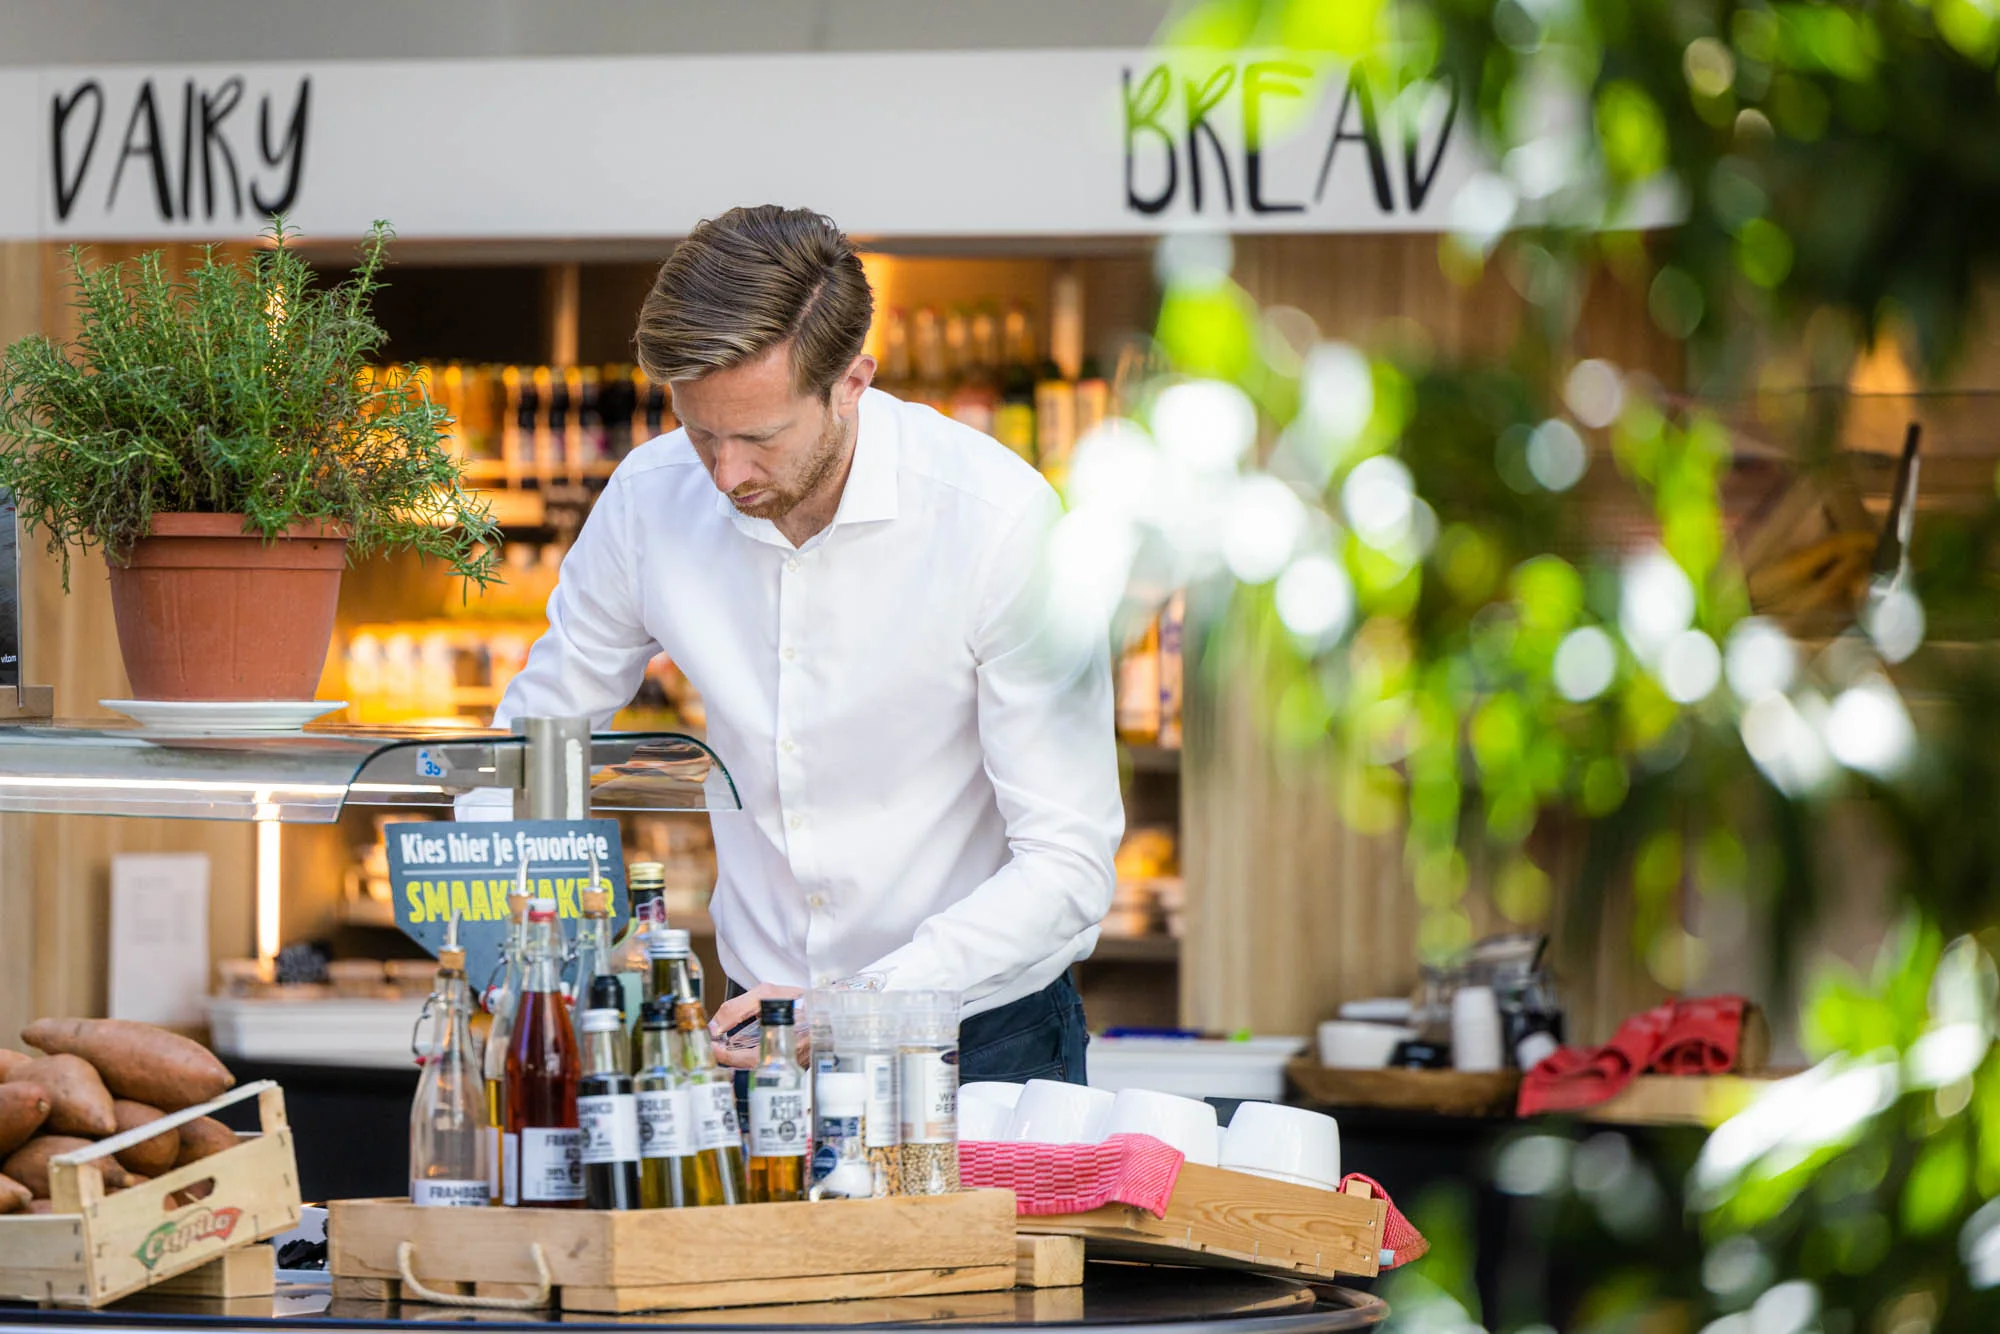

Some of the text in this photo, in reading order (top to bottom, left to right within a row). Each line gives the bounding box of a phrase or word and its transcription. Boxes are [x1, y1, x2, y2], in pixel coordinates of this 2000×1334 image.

[53, 75, 310, 218] DAIRY
[1123, 61, 1459, 213] BREAD
[401, 831, 609, 866] Kies hier je favoriete
